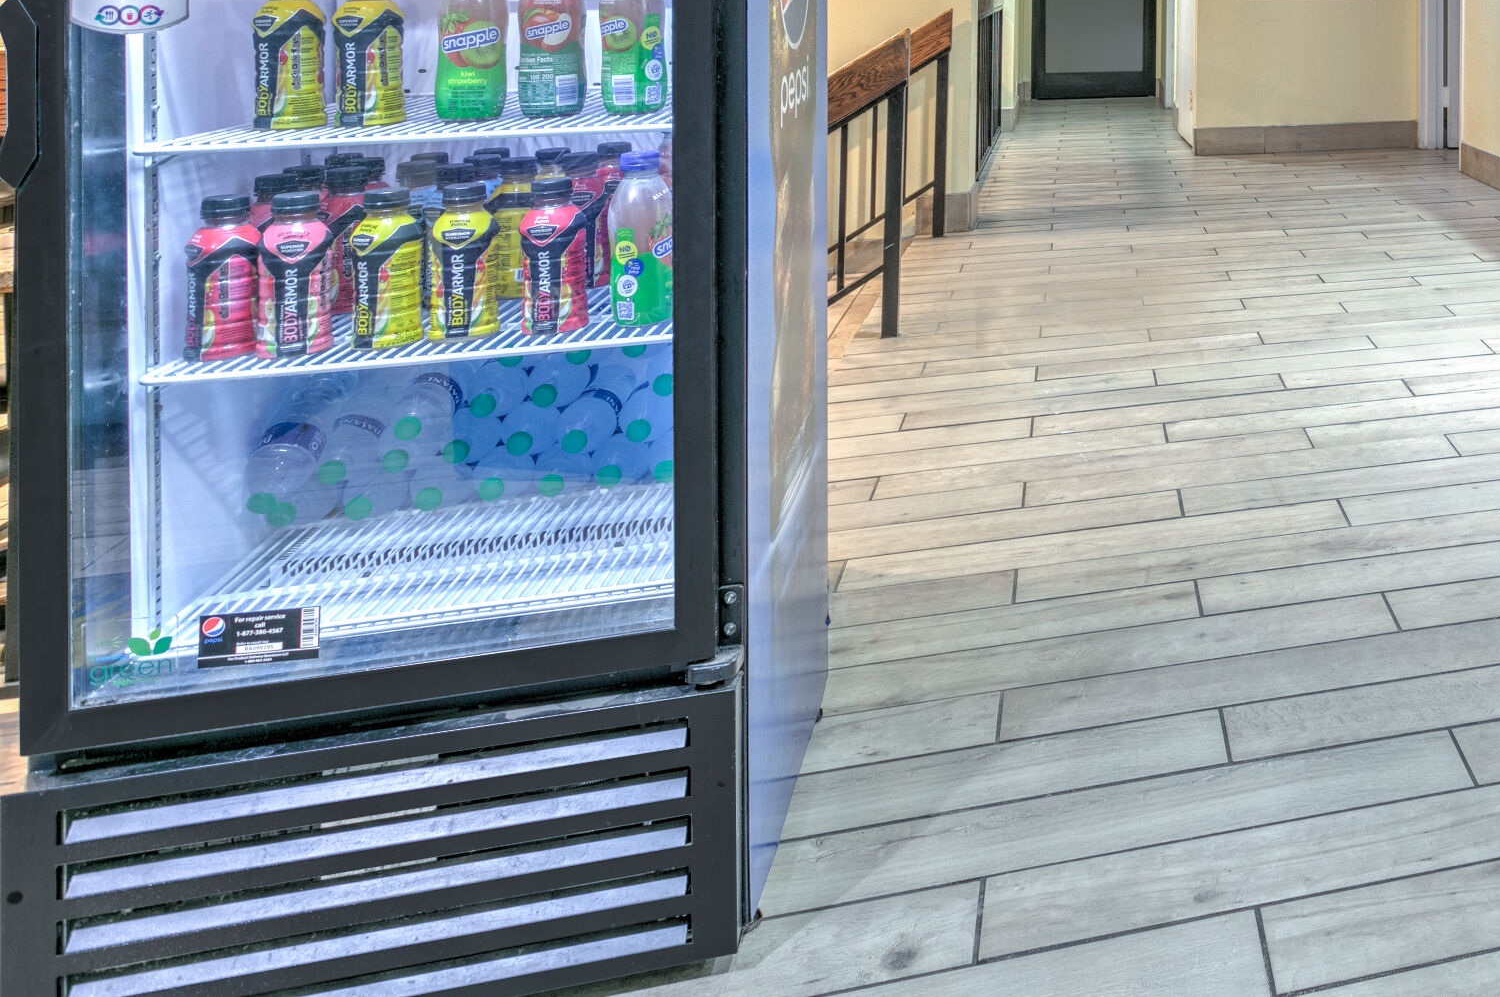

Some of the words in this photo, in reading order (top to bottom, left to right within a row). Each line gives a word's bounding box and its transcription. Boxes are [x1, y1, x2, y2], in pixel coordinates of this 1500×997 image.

[443, 27, 498, 50] snapple
[527, 20, 569, 38] snapple
[601, 19, 624, 33] apple
[257, 42, 269, 116] BODYARMOR
[344, 41, 357, 114] BODYARMOR
[447, 77, 488, 86] strawberry
[780, 54, 809, 129] pepsi
[357, 261, 369, 336] BODYARMOR
[451, 253, 464, 327] BODYARMOR
[538, 250, 551, 322] BODYARMOR
[284, 267, 298, 344] BODYARMOR
[245, 614, 264, 623] repair
[264, 613, 287, 621] service
[254, 621, 266, 629] call
[204, 637, 223, 645] pepsi
[89, 658, 173, 688] green
